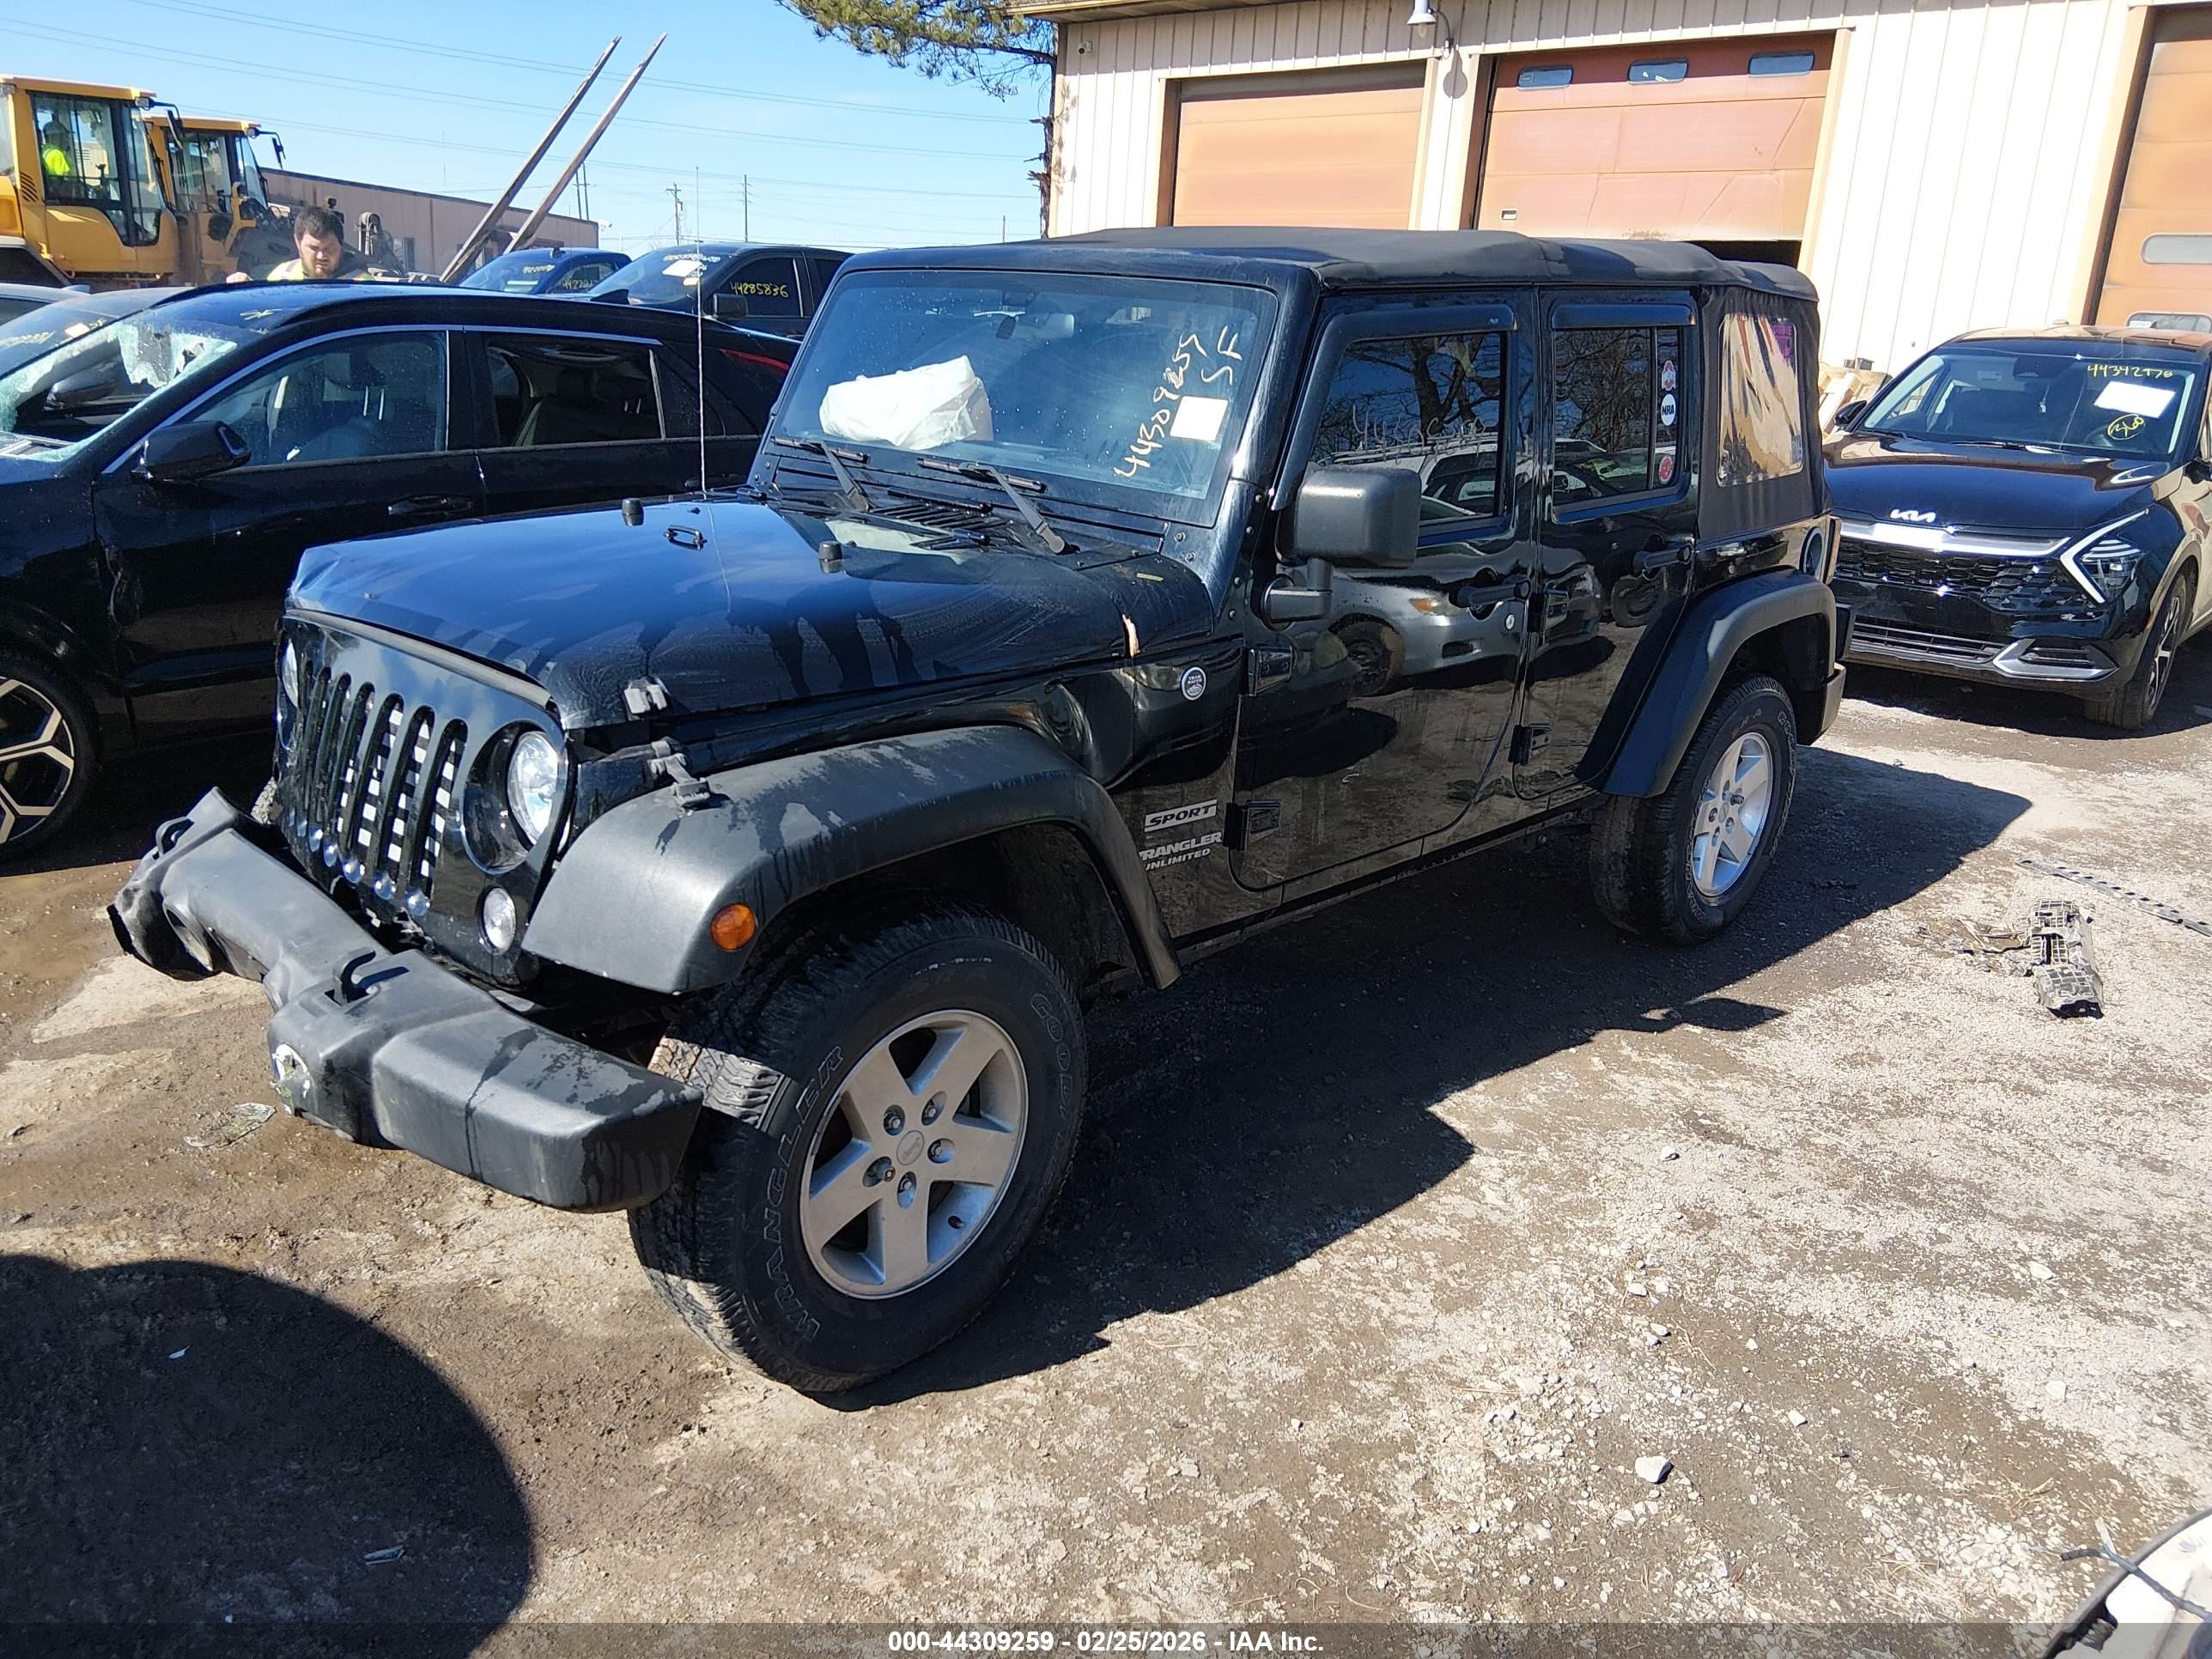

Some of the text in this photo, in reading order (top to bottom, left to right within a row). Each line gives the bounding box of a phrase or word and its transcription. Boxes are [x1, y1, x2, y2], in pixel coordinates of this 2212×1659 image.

[730, 282, 789, 298] 44285836
[1200, 325, 1243, 386] SF
[1662, 404, 1674, 416] NRA
[1150, 806, 1211, 825] SPORT
[763, 1045, 845, 1341] WRANGLER
